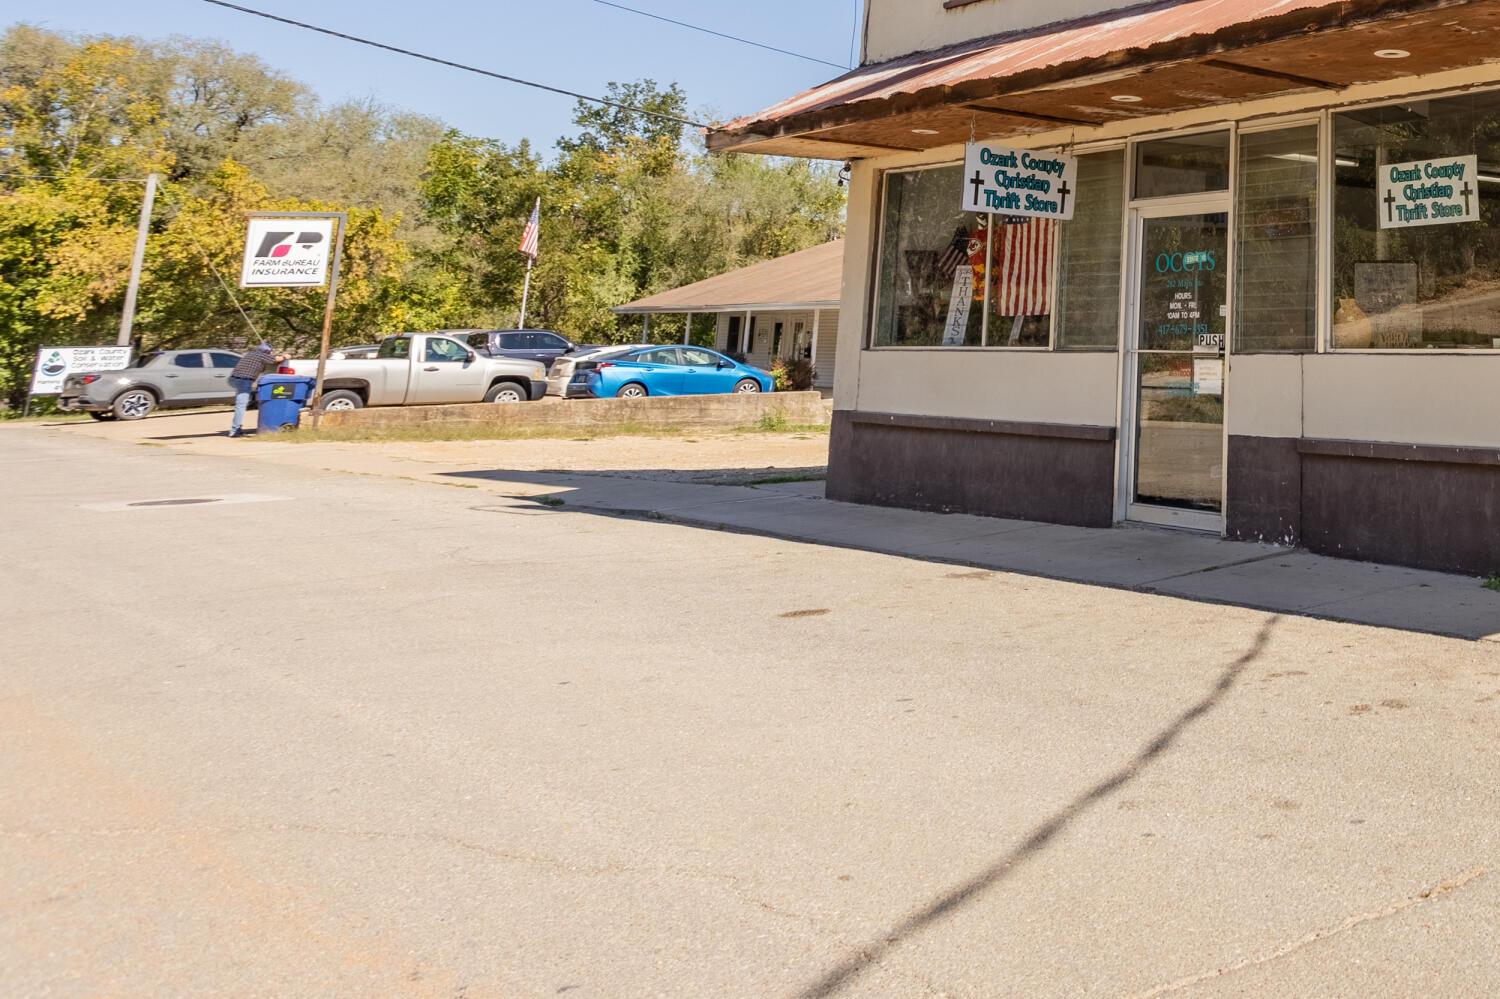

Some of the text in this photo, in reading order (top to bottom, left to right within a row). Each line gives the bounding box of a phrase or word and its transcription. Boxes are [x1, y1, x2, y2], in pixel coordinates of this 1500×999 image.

[980, 147, 1065, 178] Ozark County
[1390, 162, 1465, 183] Ozark County
[995, 169, 1051, 194] Christian
[1403, 181, 1453, 202] Christian
[984, 189, 1058, 213] Thrift Store
[1396, 201, 1463, 223] Thrift Store
[951, 276, 970, 336] THANKS
[1181, 311, 1188, 319] TO
[1200, 334, 1224, 348] PUSH
